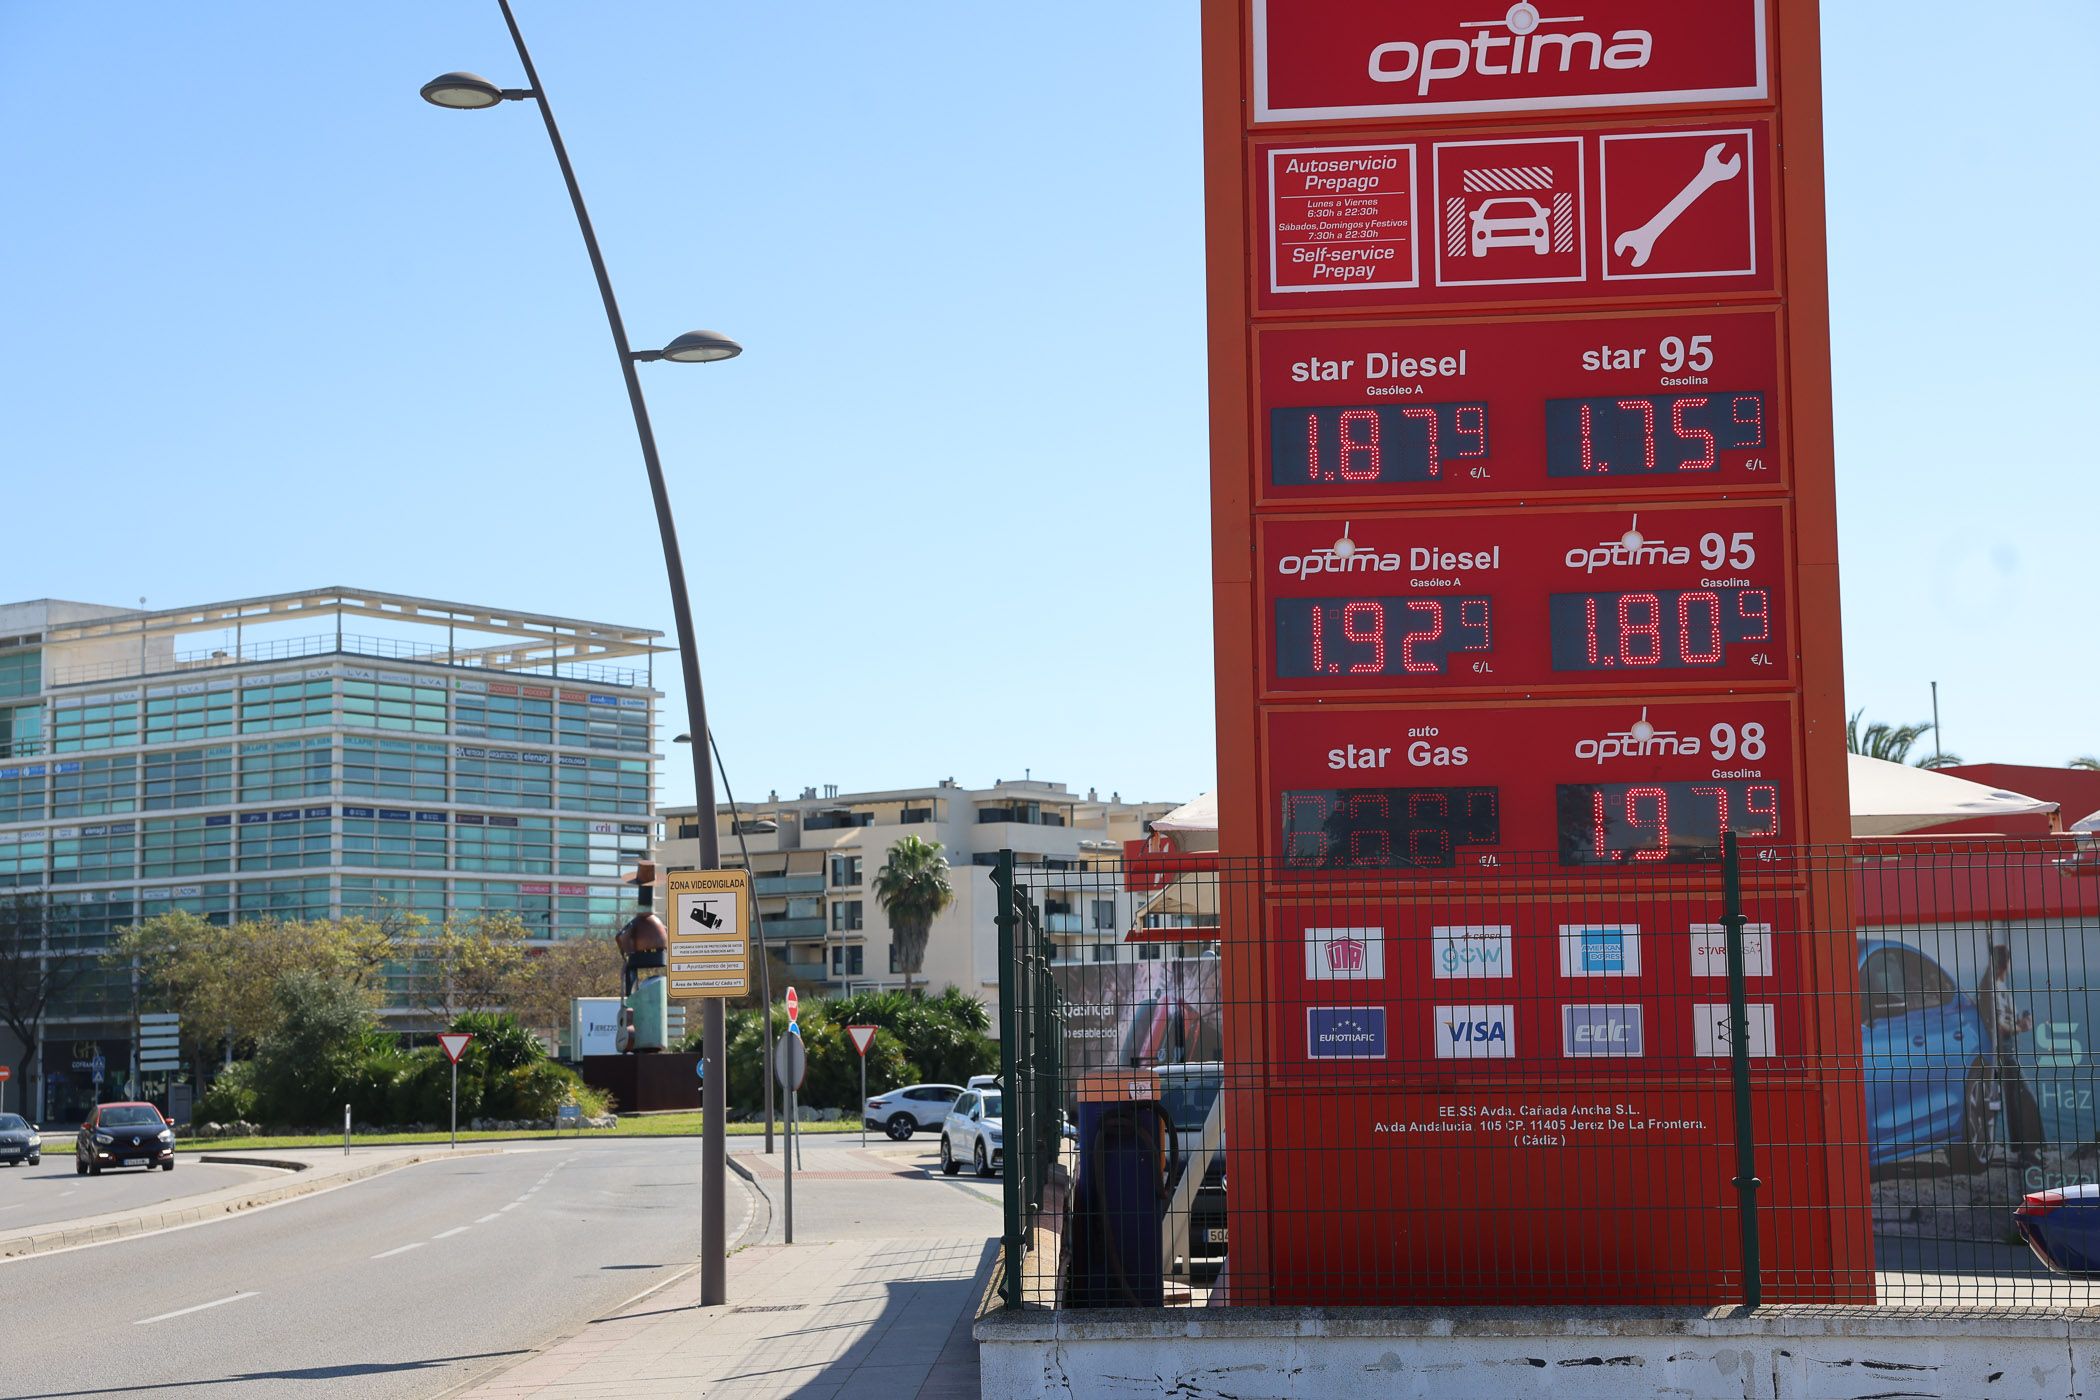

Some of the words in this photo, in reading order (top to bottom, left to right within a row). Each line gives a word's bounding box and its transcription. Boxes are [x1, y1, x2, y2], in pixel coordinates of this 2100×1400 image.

[1368, 29, 1653, 95] optima
[1286, 155, 1397, 174] Autoservicio
[1305, 175, 1379, 192] Prepago
[1307, 200, 1334, 208] Lunes
[1307, 209, 1334, 217] 6:30h
[1344, 207, 1378, 216] 22:30h
[1365, 222, 1370, 230] y
[1371, 219, 1408, 228] Festivos
[1308, 231, 1334, 240] 7:30h
[1345, 230, 1378, 239] 22:30h
[1292, 245, 1395, 263] Self-service
[1312, 263, 1376, 281] Prepay
[1582, 345, 1646, 371] star
[1659, 334, 1714, 373] 95
[1291, 357, 1355, 382] star
[1366, 349, 1467, 379] Diesel
[1660, 376, 1708, 386] Gasolina
[1366, 385, 1412, 396] Gasóleo
[1415, 385, 1423, 394] A
[1745, 458, 1767, 470] €/L
[1470, 467, 1490, 479] €/L
[1565, 544, 1690, 573] optima
[1699, 532, 1756, 571] 95
[1279, 551, 1401, 580] optima
[1410, 546, 1499, 571] Diesel
[1410, 578, 1451, 588] Gasóleo
[1453, 578, 1461, 586] A
[1700, 577, 1750, 588] Gasolina
[1750, 653, 1773, 665] €/L
[1472, 661, 1493, 673] €/L
[1408, 725, 1439, 737] auto
[1574, 736, 1701, 765] optima
[1709, 722, 1767, 761] 98
[1328, 744, 1391, 770] star
[1407, 741, 1469, 766] Gas
[1711, 769, 1761, 779] Gasolina
[670, 880, 690, 890] ZONA
[691, 879, 745, 889] VIDEOVIGILADA
[1062, 1000, 1114, 1019] Qashqai
[1446, 1021, 1505, 1042] VISA
[1575, 1019, 1632, 1042] edc
[1319, 1033, 1375, 1042] EUROTRAFIC
[2041, 1083, 2092, 1109] Haz
[1480, 1105, 1515, 1116] Avda.
[1520, 1105, 1567, 1116] Cañada
[1571, 1104, 1611, 1115] Ancha
[1615, 1104, 1640, 1115] S.L.
[1374, 1122, 1406, 1132] Avda
[1480, 1120, 1501, 1131] 105
[1506, 1120, 1526, 1131] CP.
[1531, 1119, 1566, 1130] 11405
[1569, 1119, 1604, 1130] Jerez
[1608, 1119, 1625, 1129] De
[1629, 1119, 1644, 1129] La
